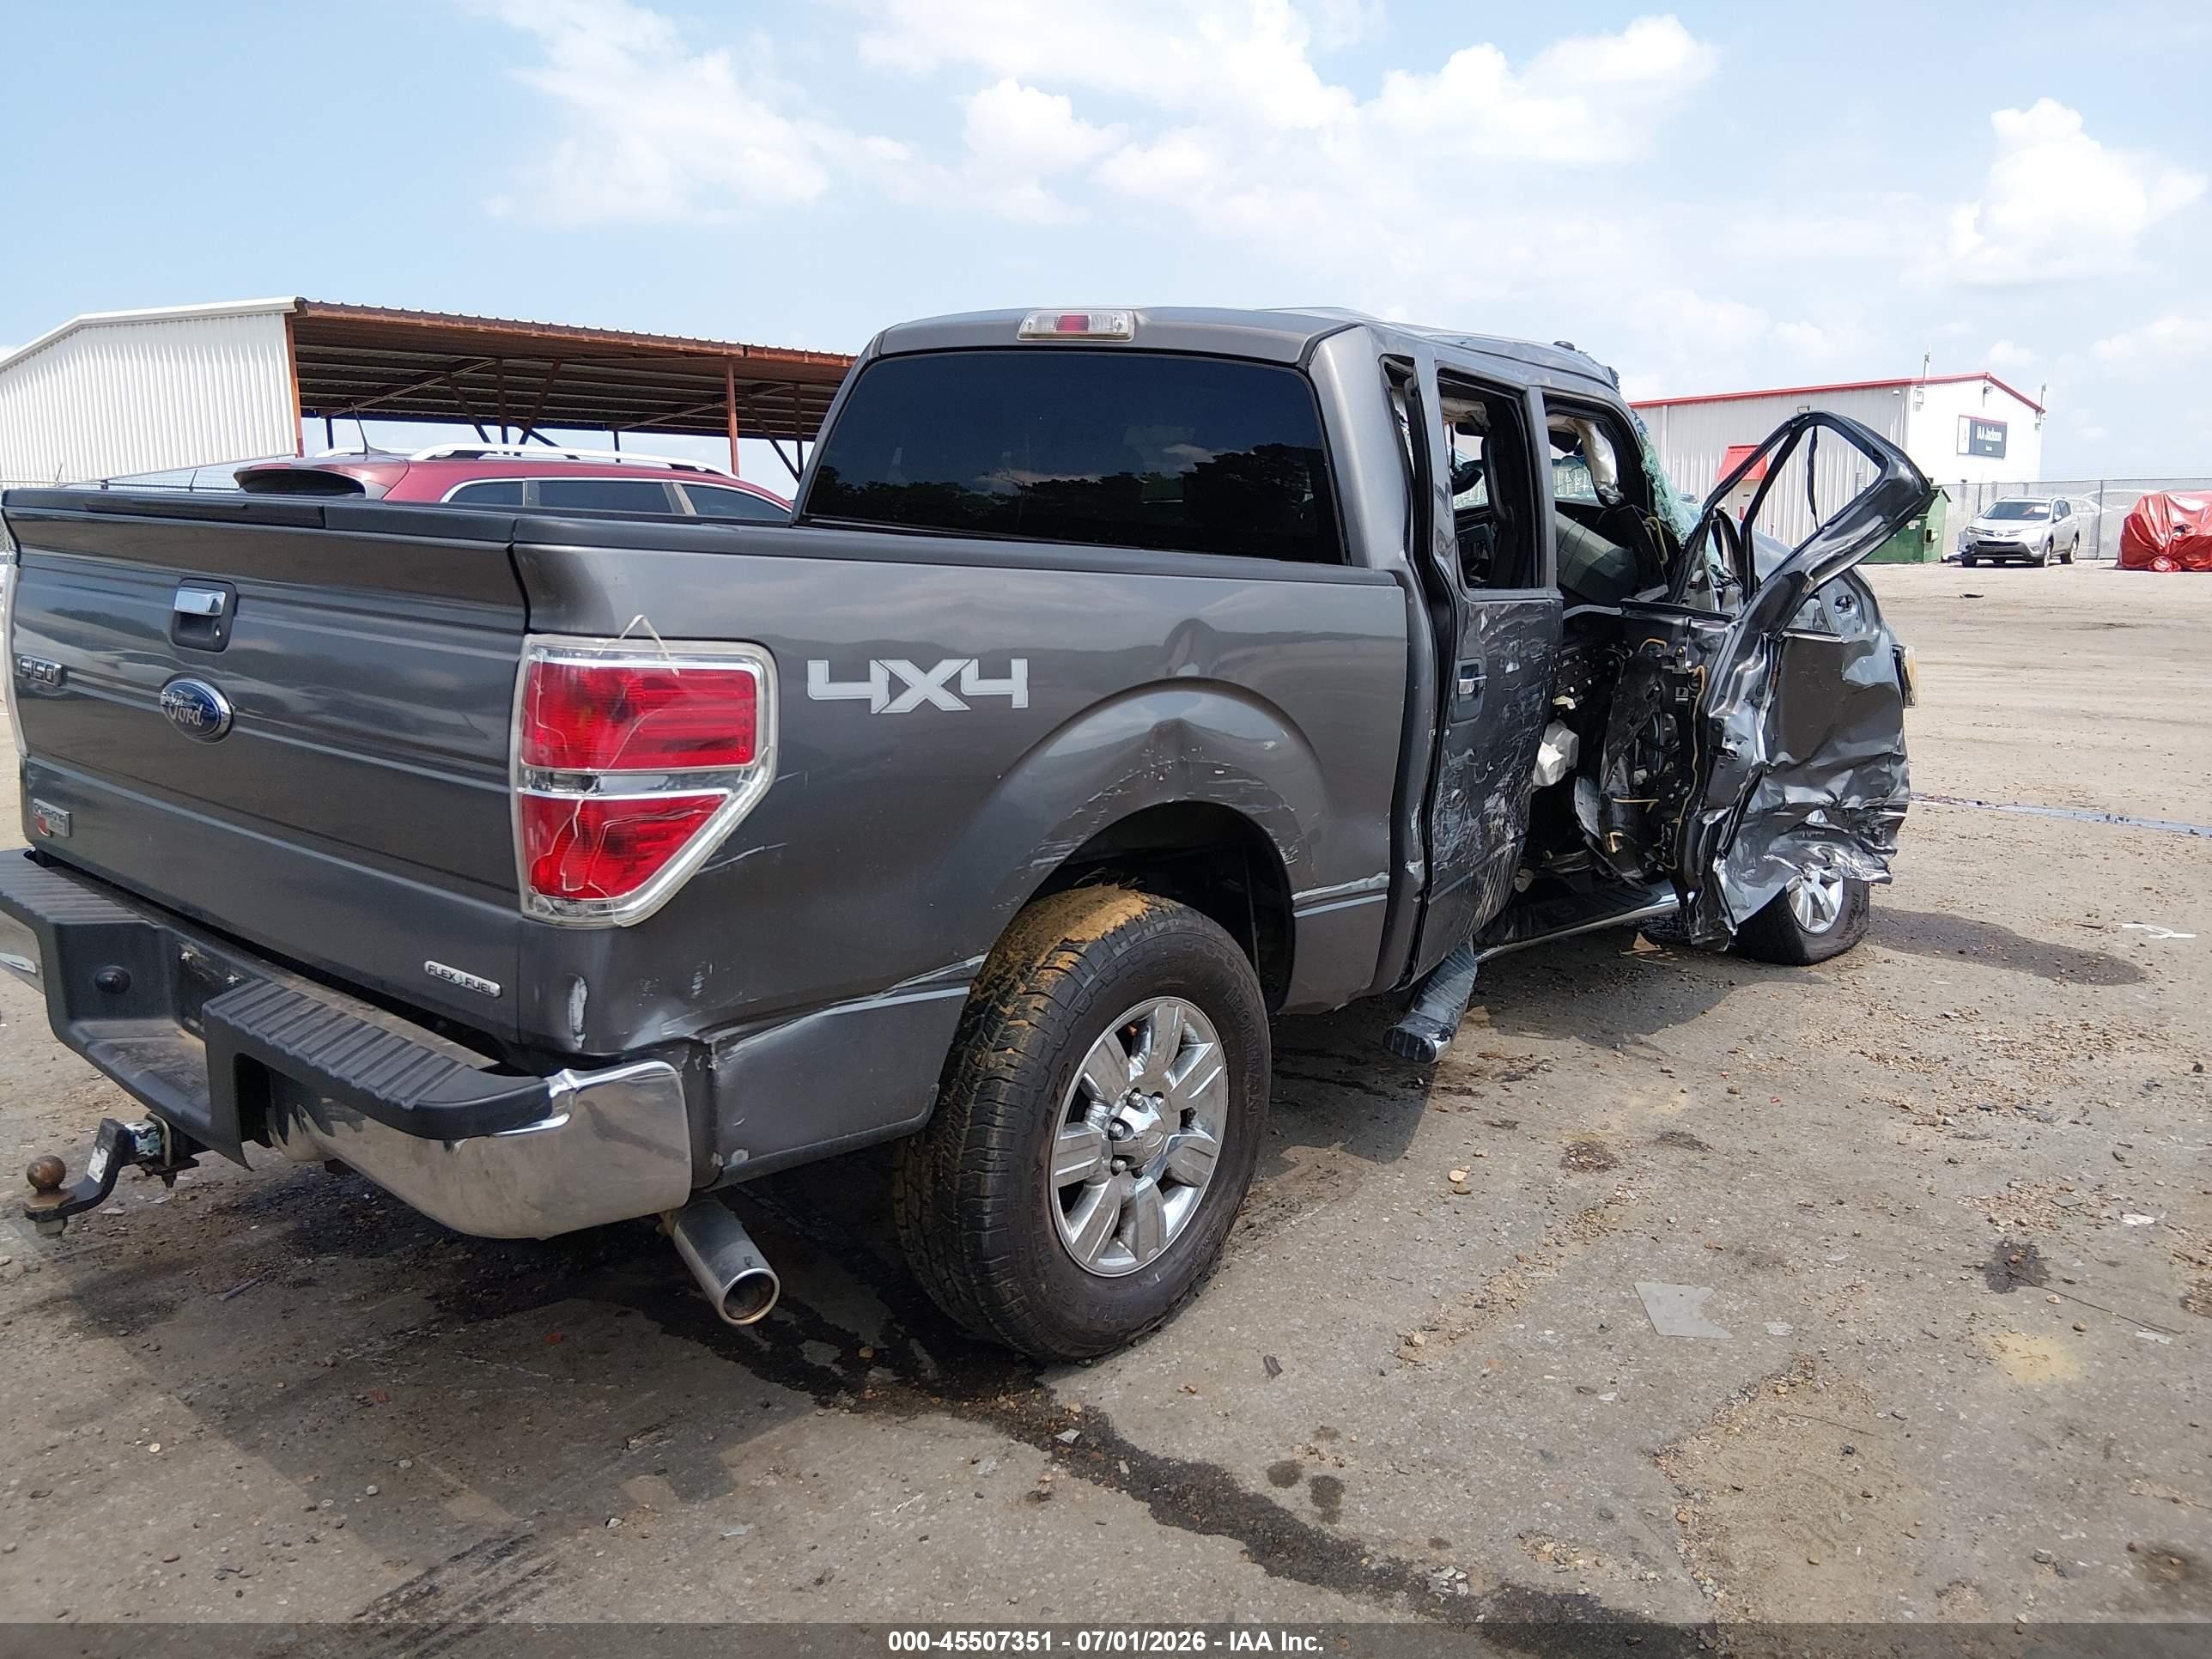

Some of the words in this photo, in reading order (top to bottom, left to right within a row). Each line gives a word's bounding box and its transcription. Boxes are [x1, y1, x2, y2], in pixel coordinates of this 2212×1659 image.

[167, 689, 204, 726] Ford
[427, 963, 457, 982] FLEX
[465, 976, 495, 995] FUEL
